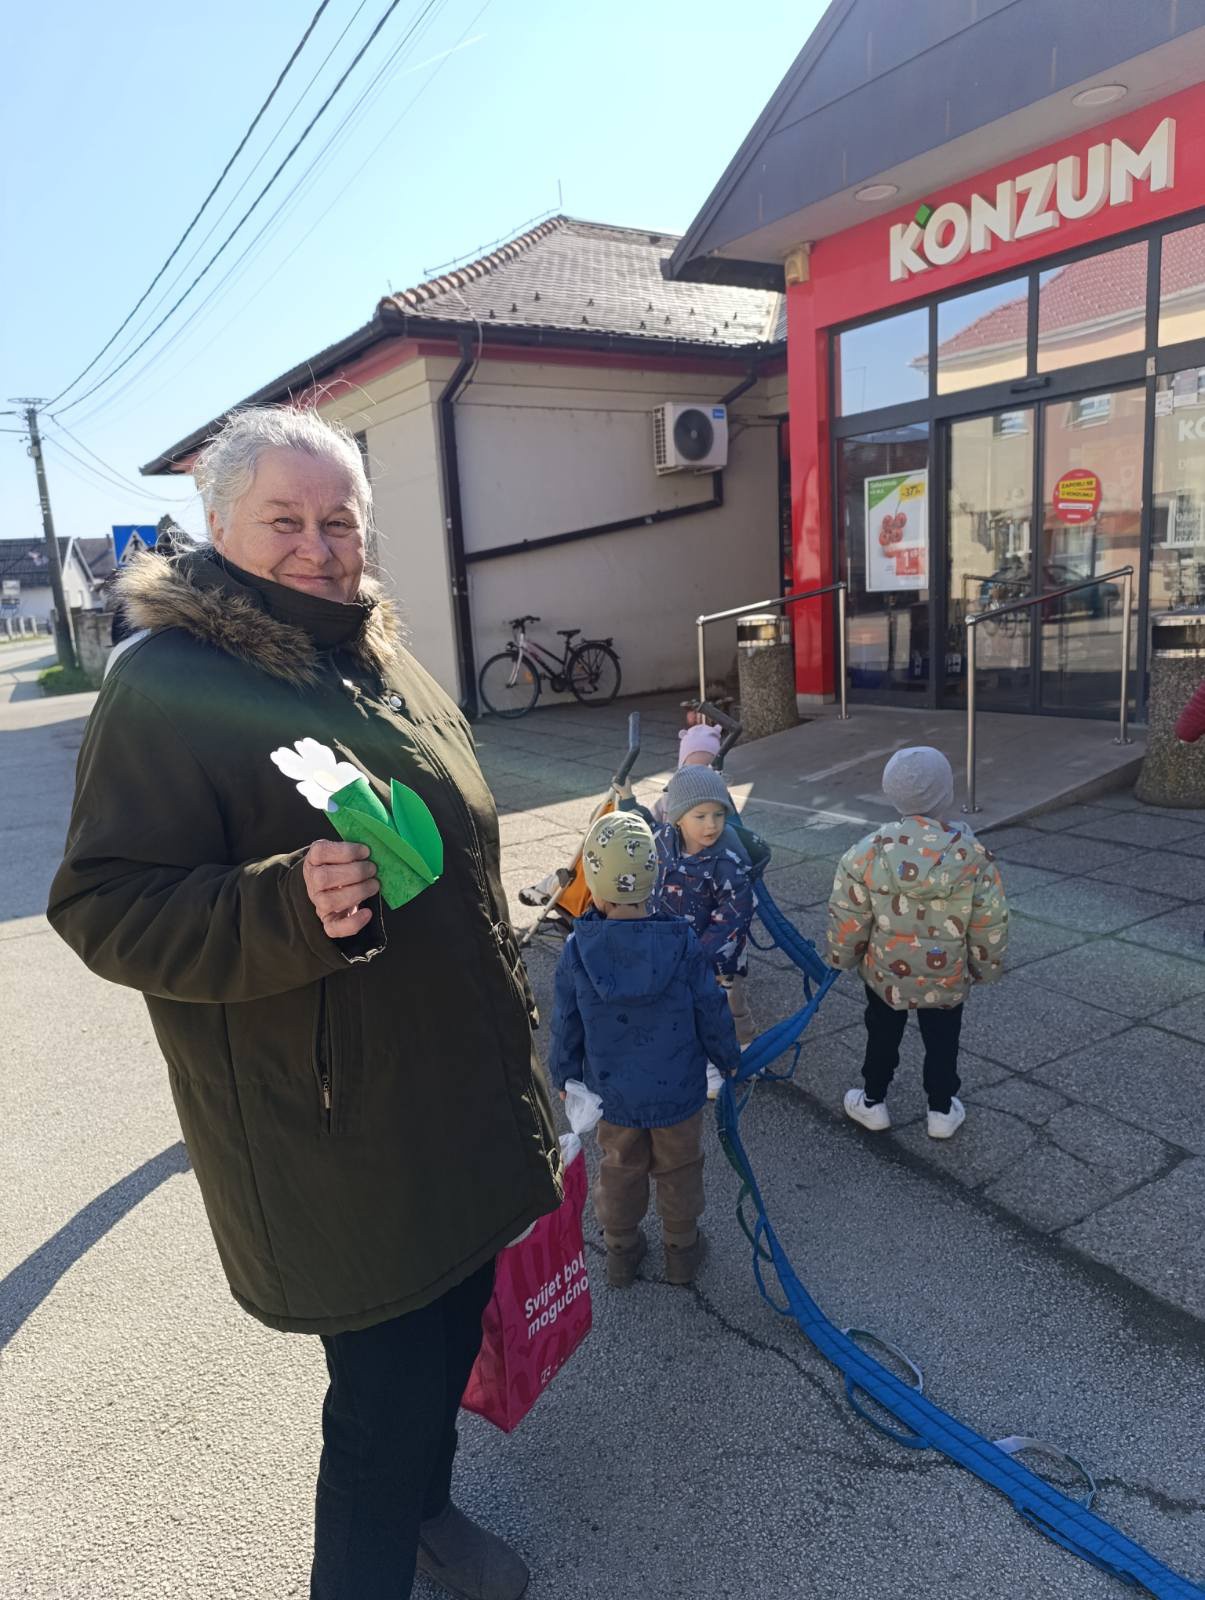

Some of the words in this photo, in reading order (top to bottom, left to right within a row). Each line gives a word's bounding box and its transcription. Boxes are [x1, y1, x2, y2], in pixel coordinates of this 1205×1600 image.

[890, 117, 1176, 282] KONZUM
[525, 1272, 562, 1319] Svijet
[564, 1250, 587, 1284] bol
[528, 1276, 588, 1340] mogućno
